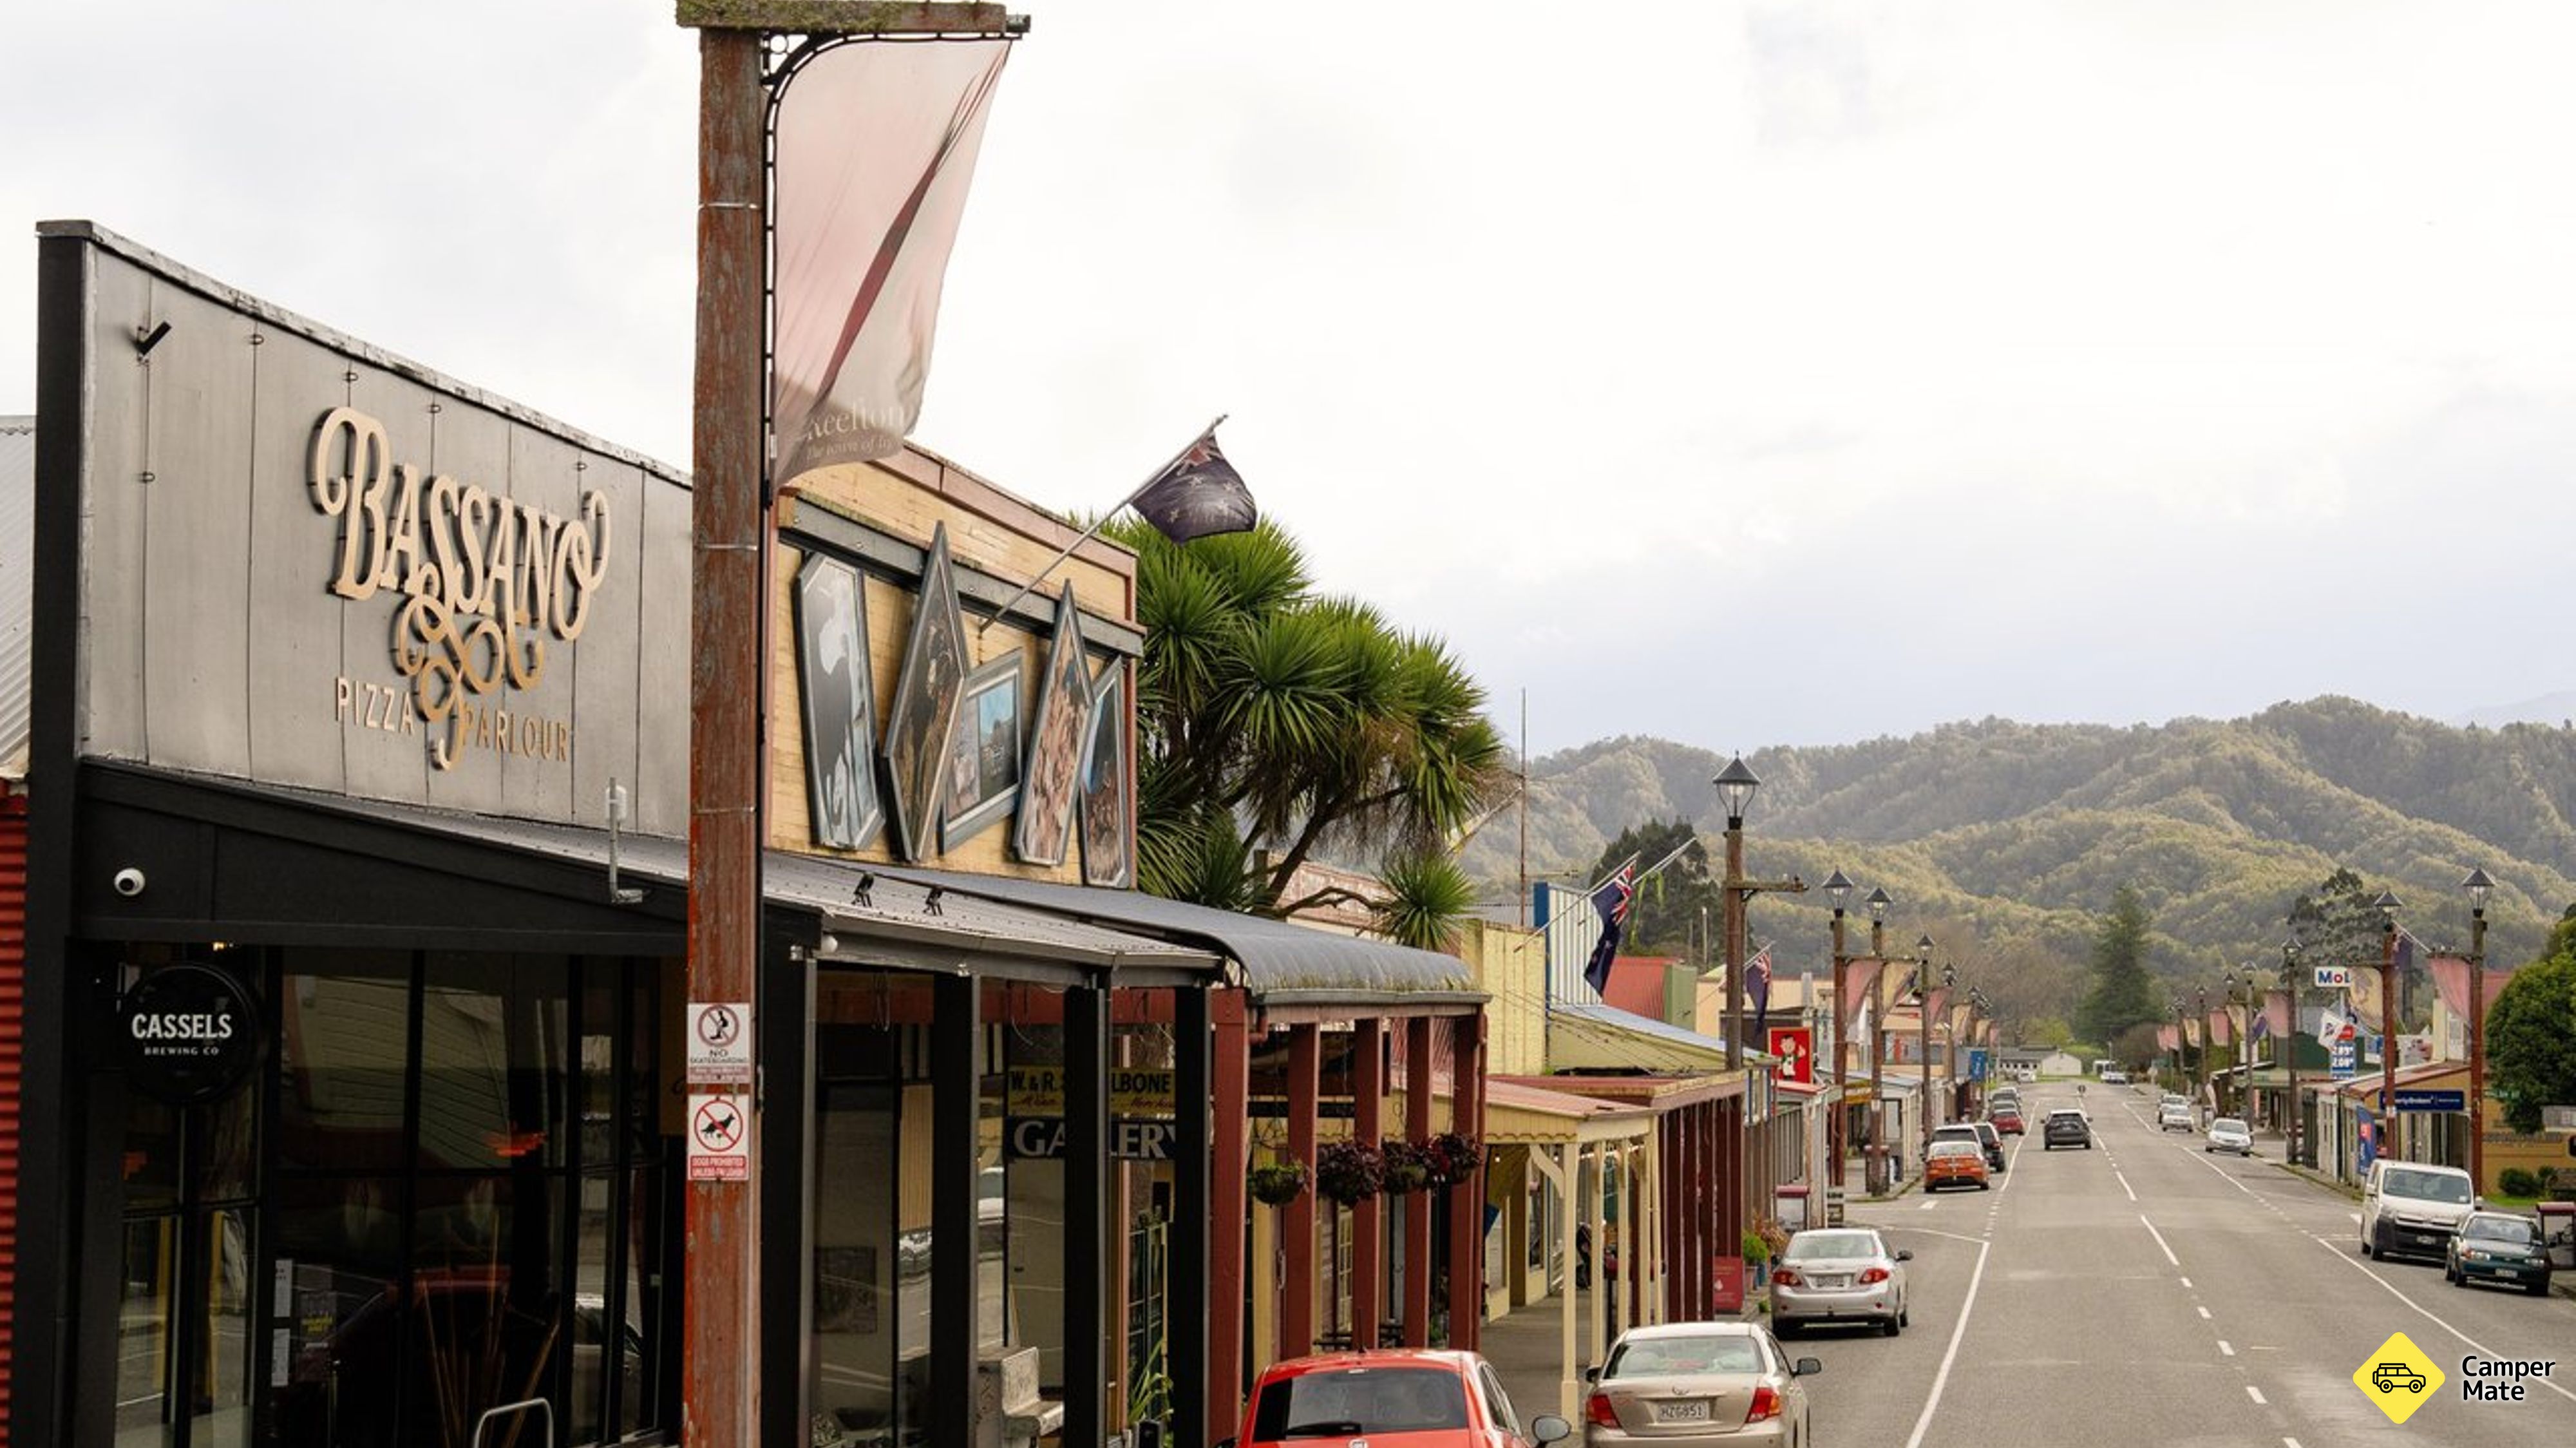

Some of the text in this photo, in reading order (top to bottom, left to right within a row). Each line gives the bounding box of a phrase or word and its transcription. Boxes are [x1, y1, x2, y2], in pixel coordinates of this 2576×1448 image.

[307, 406, 611, 683] BASSANO
[336, 677, 567, 762] PIZZA PARLOUR
[132, 1013, 232, 1039] CASSELS
[144, 1047, 220, 1056] BREWING CO
[710, 1049, 729, 1057] NO
